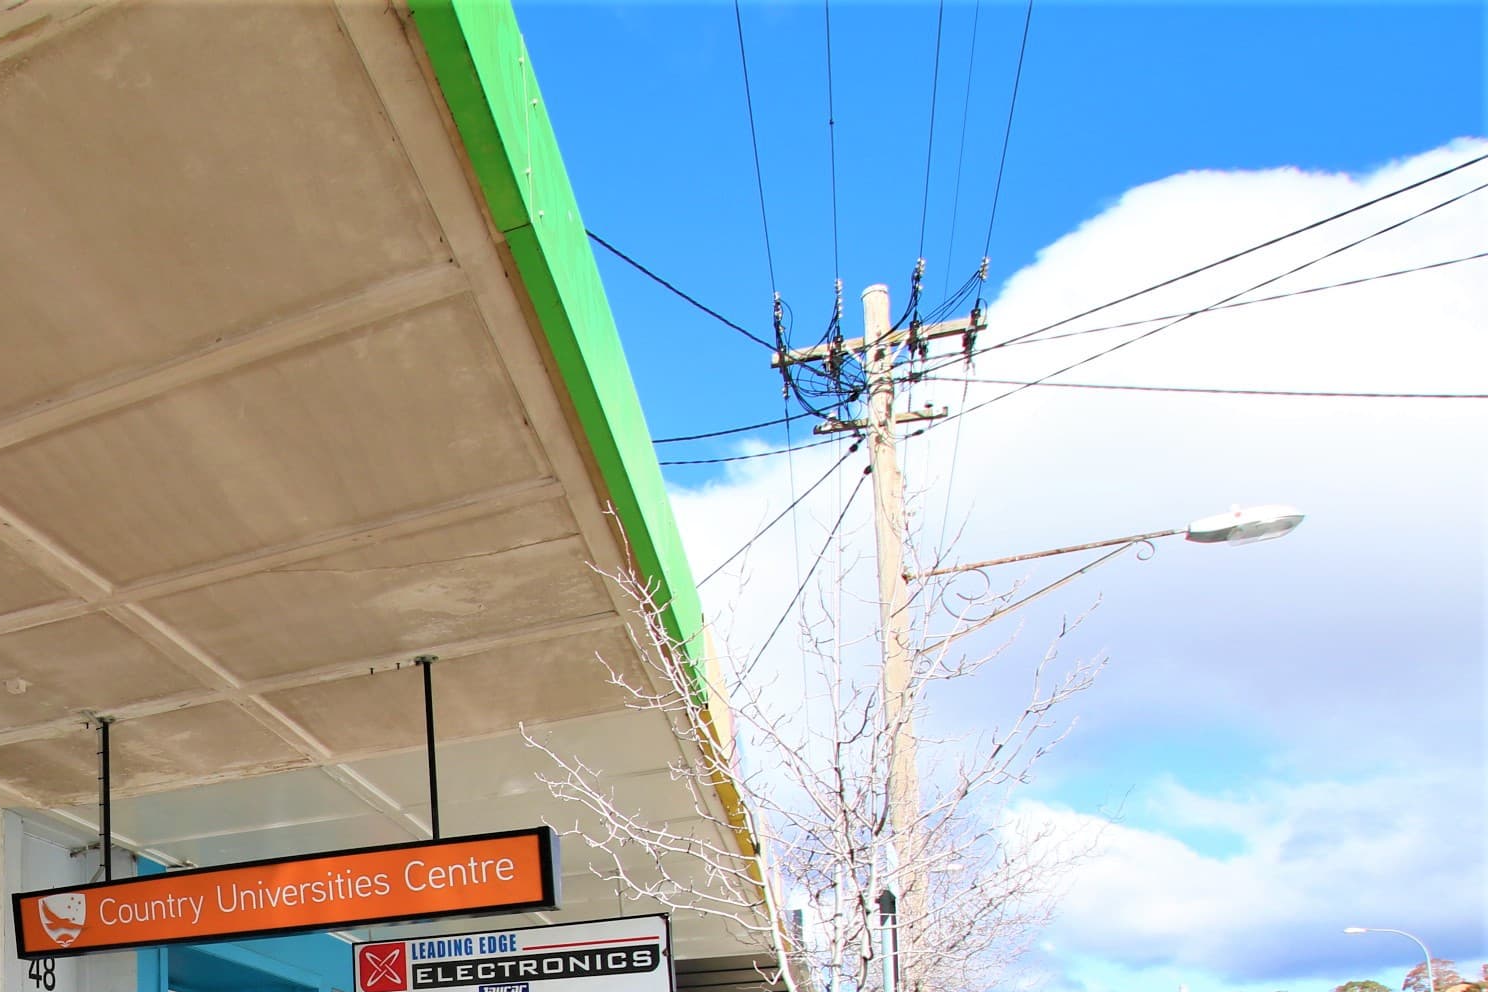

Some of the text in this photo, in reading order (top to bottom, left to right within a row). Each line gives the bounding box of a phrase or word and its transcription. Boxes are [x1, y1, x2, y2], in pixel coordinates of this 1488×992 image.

[99, 855, 515, 926] Country Universities Centre
[411, 933, 517, 961] LEADING EDGE
[28, 958, 56, 991] 48
[416, 948, 653, 985] ELECTRONICS
